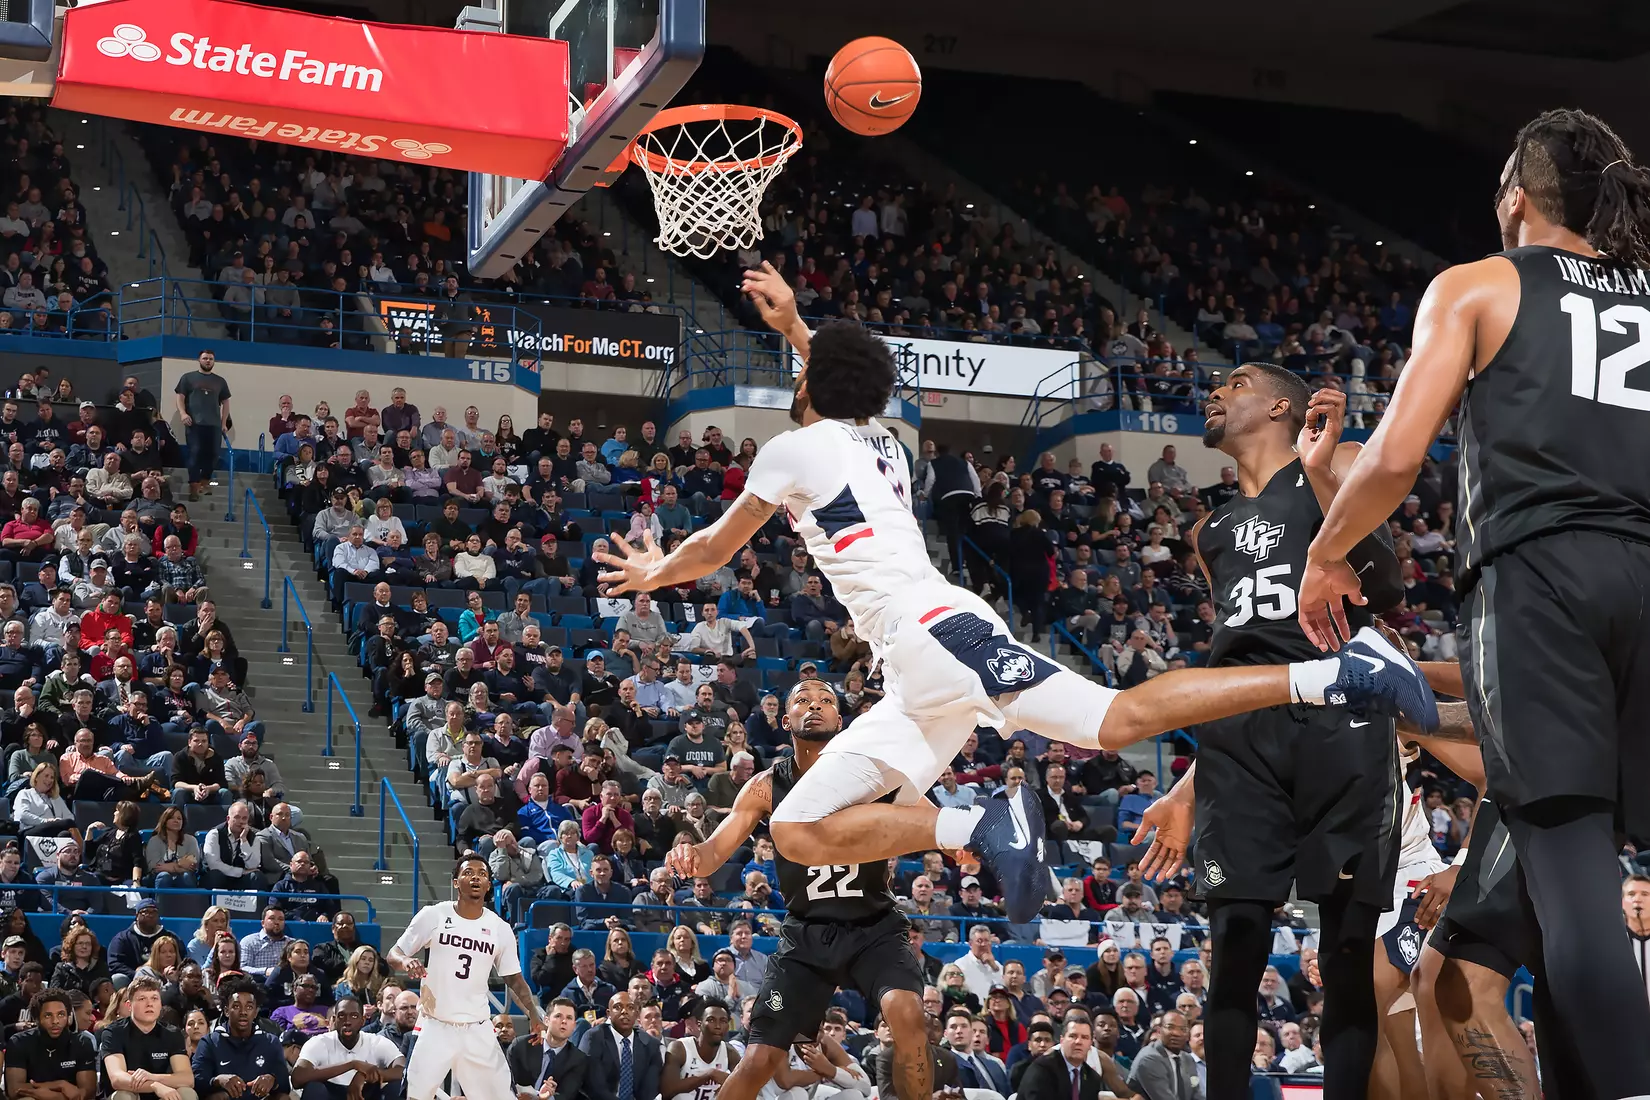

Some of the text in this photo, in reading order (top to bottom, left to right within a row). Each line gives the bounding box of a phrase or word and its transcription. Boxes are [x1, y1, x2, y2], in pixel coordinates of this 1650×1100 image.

[507, 330, 674, 365] WatchForMeCT.org
[468, 361, 511, 382] 115
[1139, 413, 1178, 433] 116
[1231, 515, 1285, 563] UCF
[1224, 563, 1297, 628] 35
[686, 751, 714, 762] UCONN
[806, 864, 864, 901] 22
[439, 933, 495, 955] UCONN
[455, 954, 472, 979] 3
